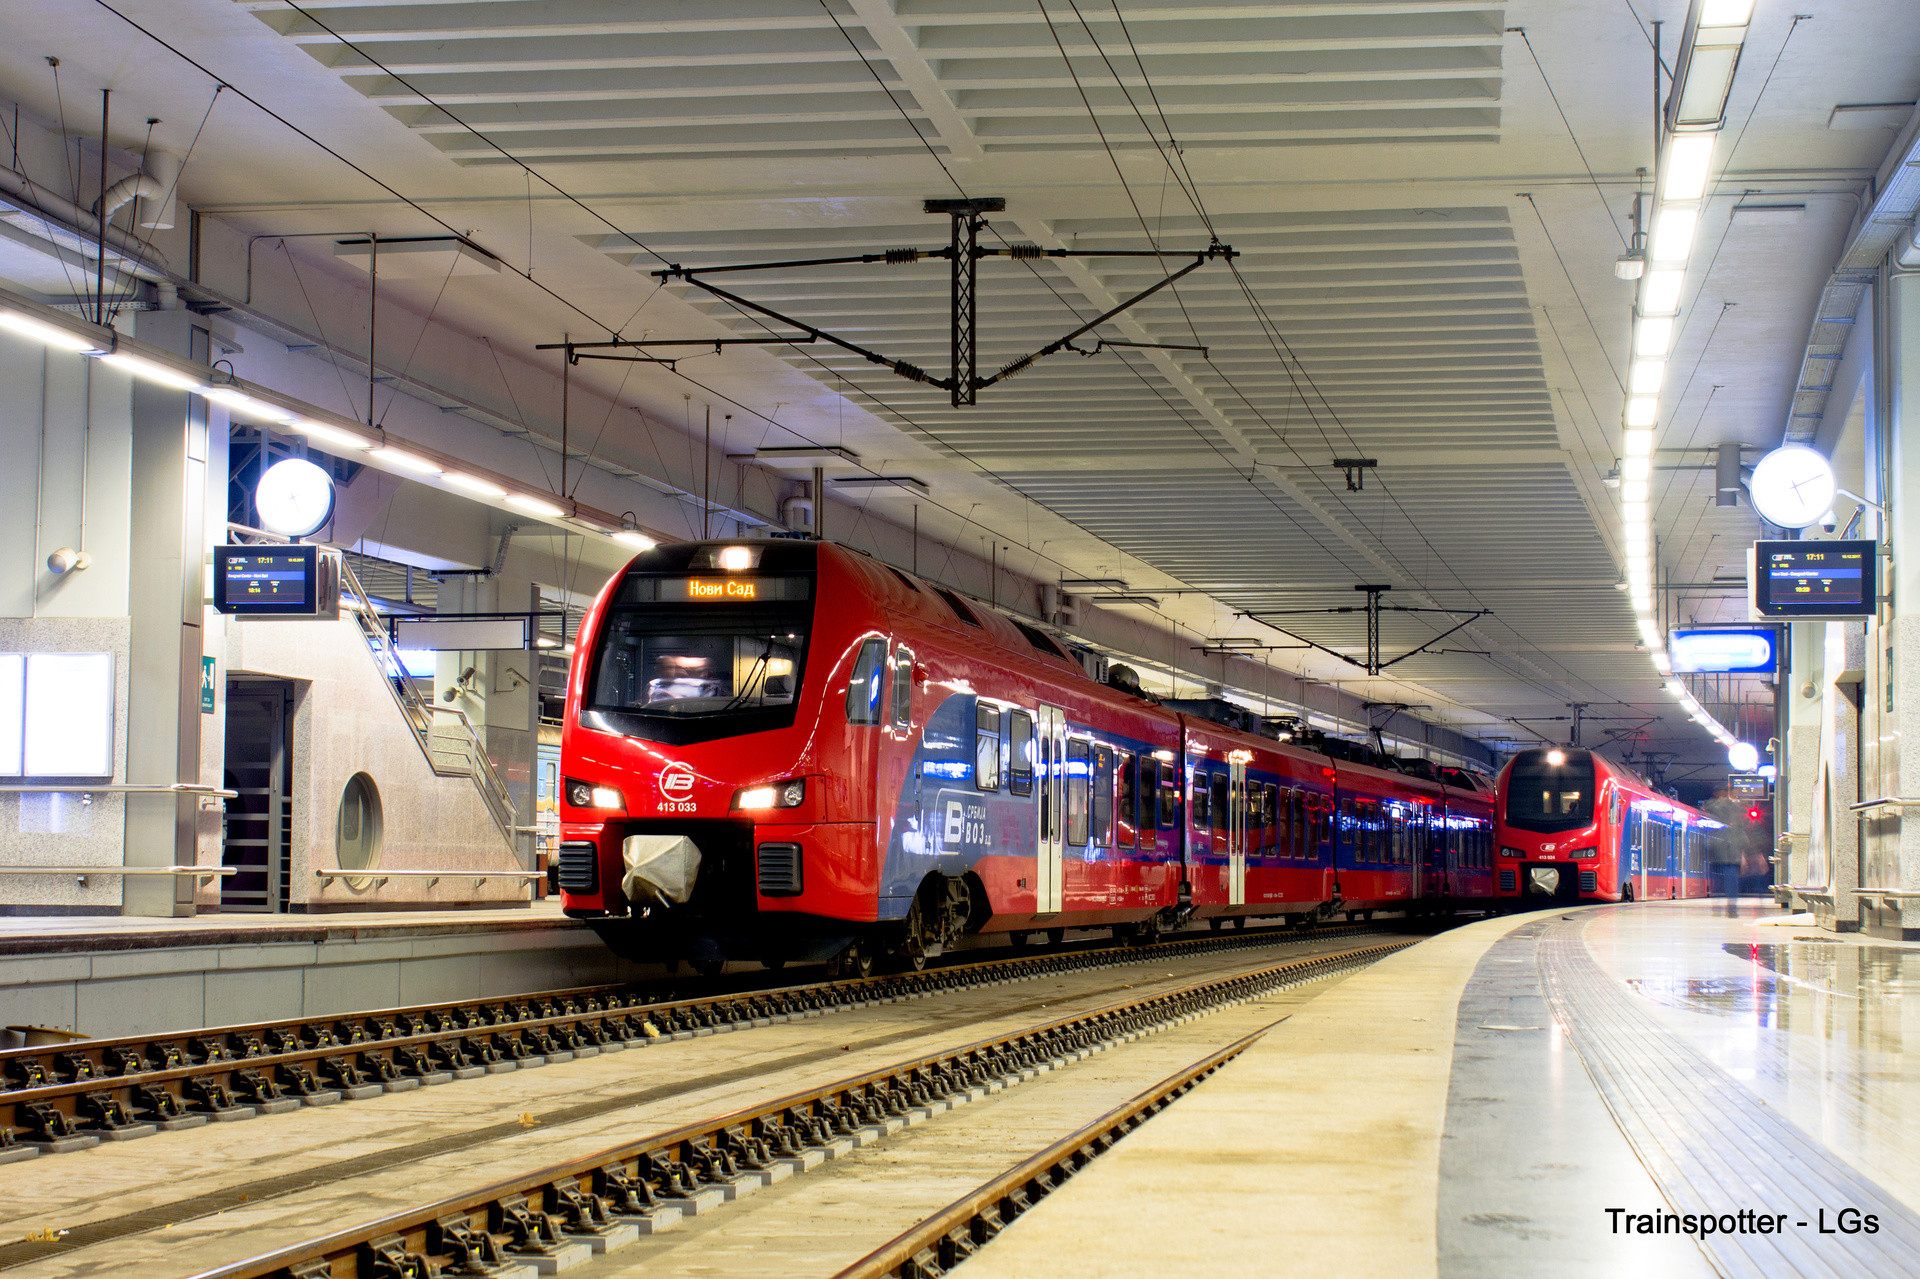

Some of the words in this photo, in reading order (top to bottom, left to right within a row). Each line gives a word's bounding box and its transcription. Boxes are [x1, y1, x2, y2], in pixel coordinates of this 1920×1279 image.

[1806, 553, 1825, 561] 17:11
[690, 581, 723, 596] Нови
[726, 581, 755, 598] Сад
[657, 802, 675, 812] 413
[678, 802, 697, 812] 033
